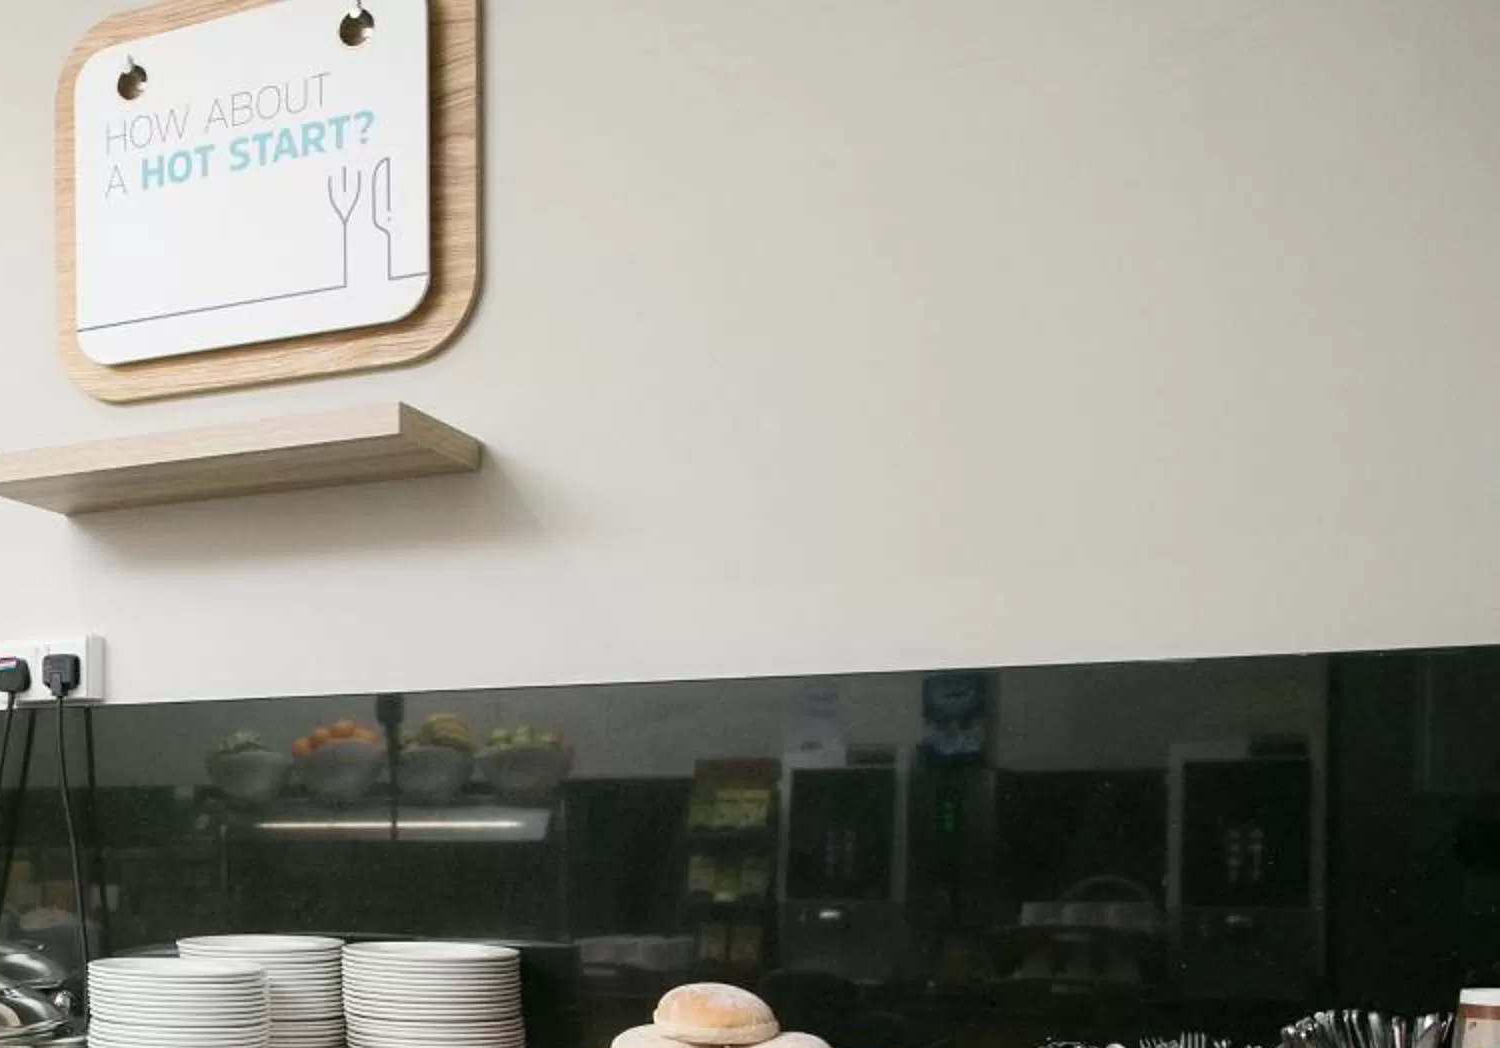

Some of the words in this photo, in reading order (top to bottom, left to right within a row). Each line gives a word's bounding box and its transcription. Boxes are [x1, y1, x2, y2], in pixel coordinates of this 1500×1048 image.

[104, 164, 128, 199] A
[141, 144, 215, 190] HOT
[229, 110, 375, 172] START?
[105, 105, 190, 155] HOW
[204, 72, 330, 134] ABOUT
